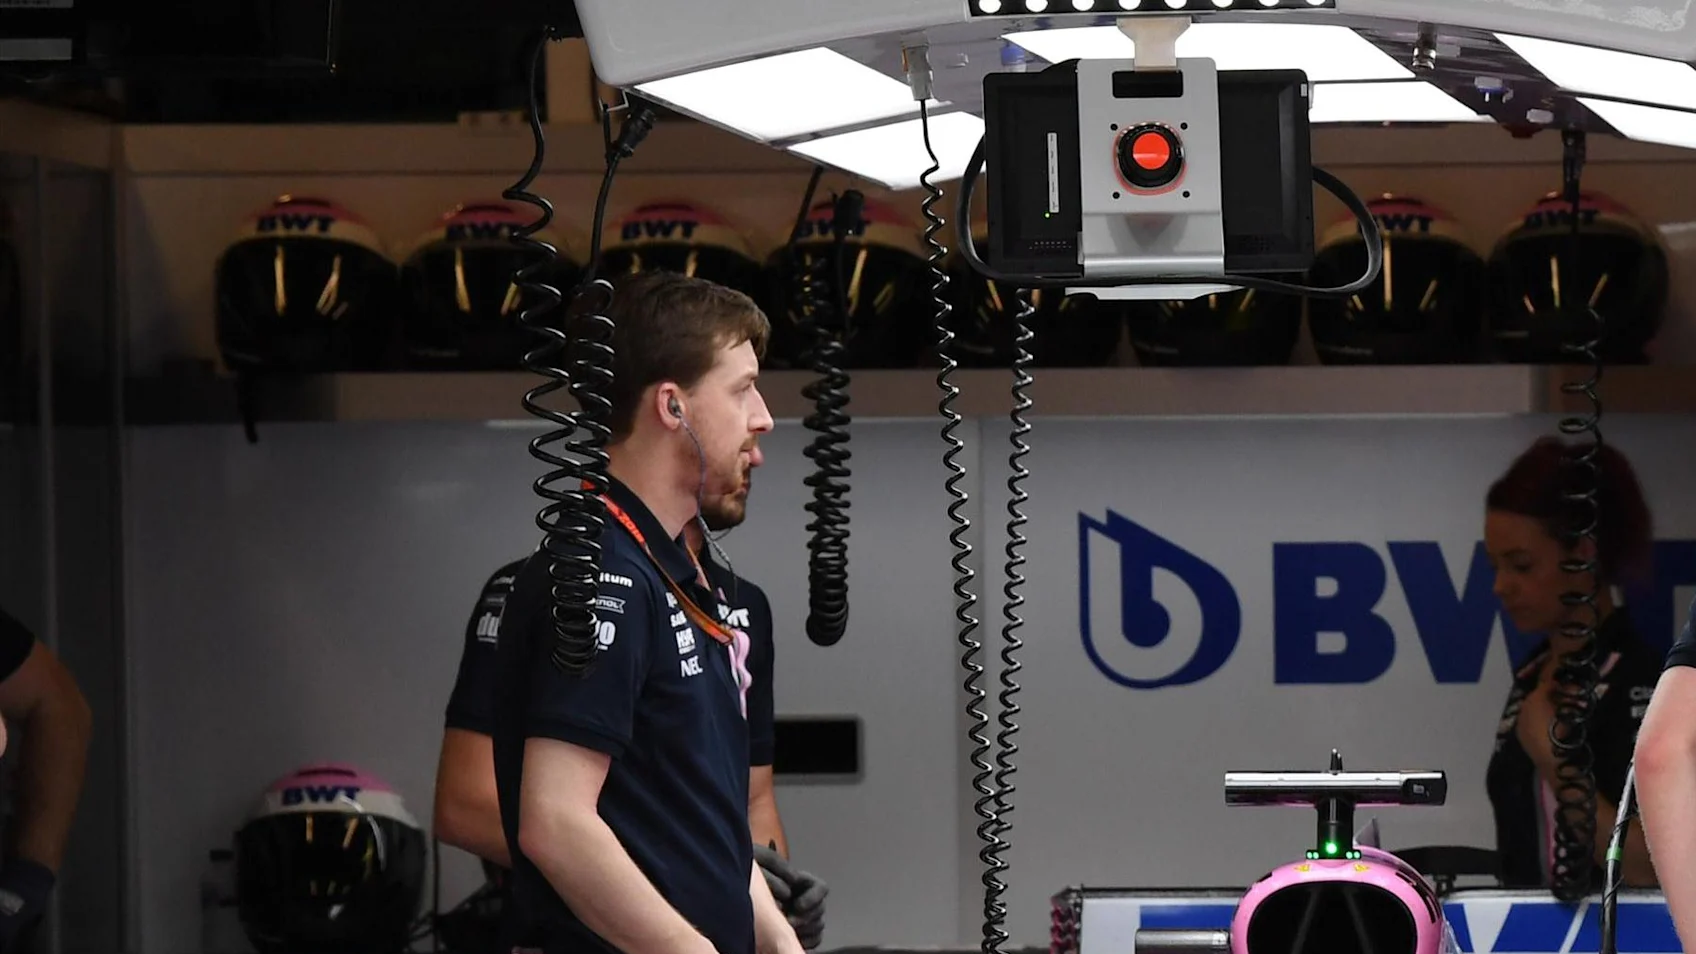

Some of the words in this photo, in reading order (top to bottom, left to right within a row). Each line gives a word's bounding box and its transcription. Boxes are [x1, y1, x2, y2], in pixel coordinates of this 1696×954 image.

[256, 213, 335, 233] BWT
[621, 218, 698, 239] BWT
[281, 785, 360, 806] BWT
